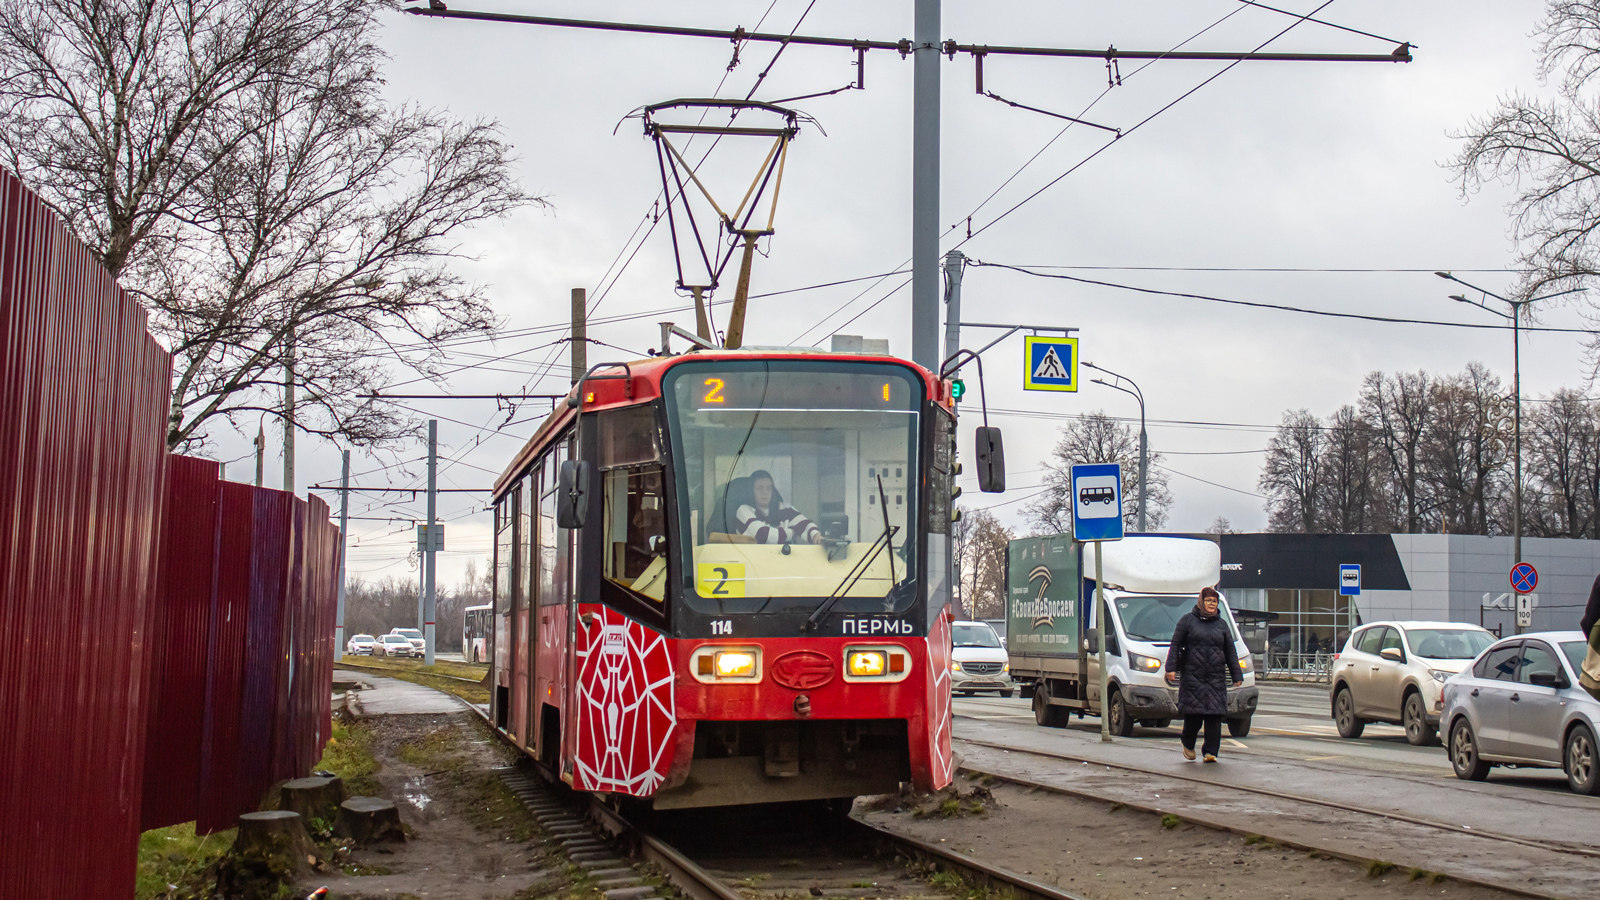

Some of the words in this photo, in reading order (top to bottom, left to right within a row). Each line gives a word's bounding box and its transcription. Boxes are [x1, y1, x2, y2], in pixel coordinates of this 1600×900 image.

[704, 378, 725, 403] 2
[882, 383, 890, 402] 1
[712, 567, 729, 595] 2
[710, 620, 733, 635] 114
[842, 619, 913, 634] ПЕРМЬ
